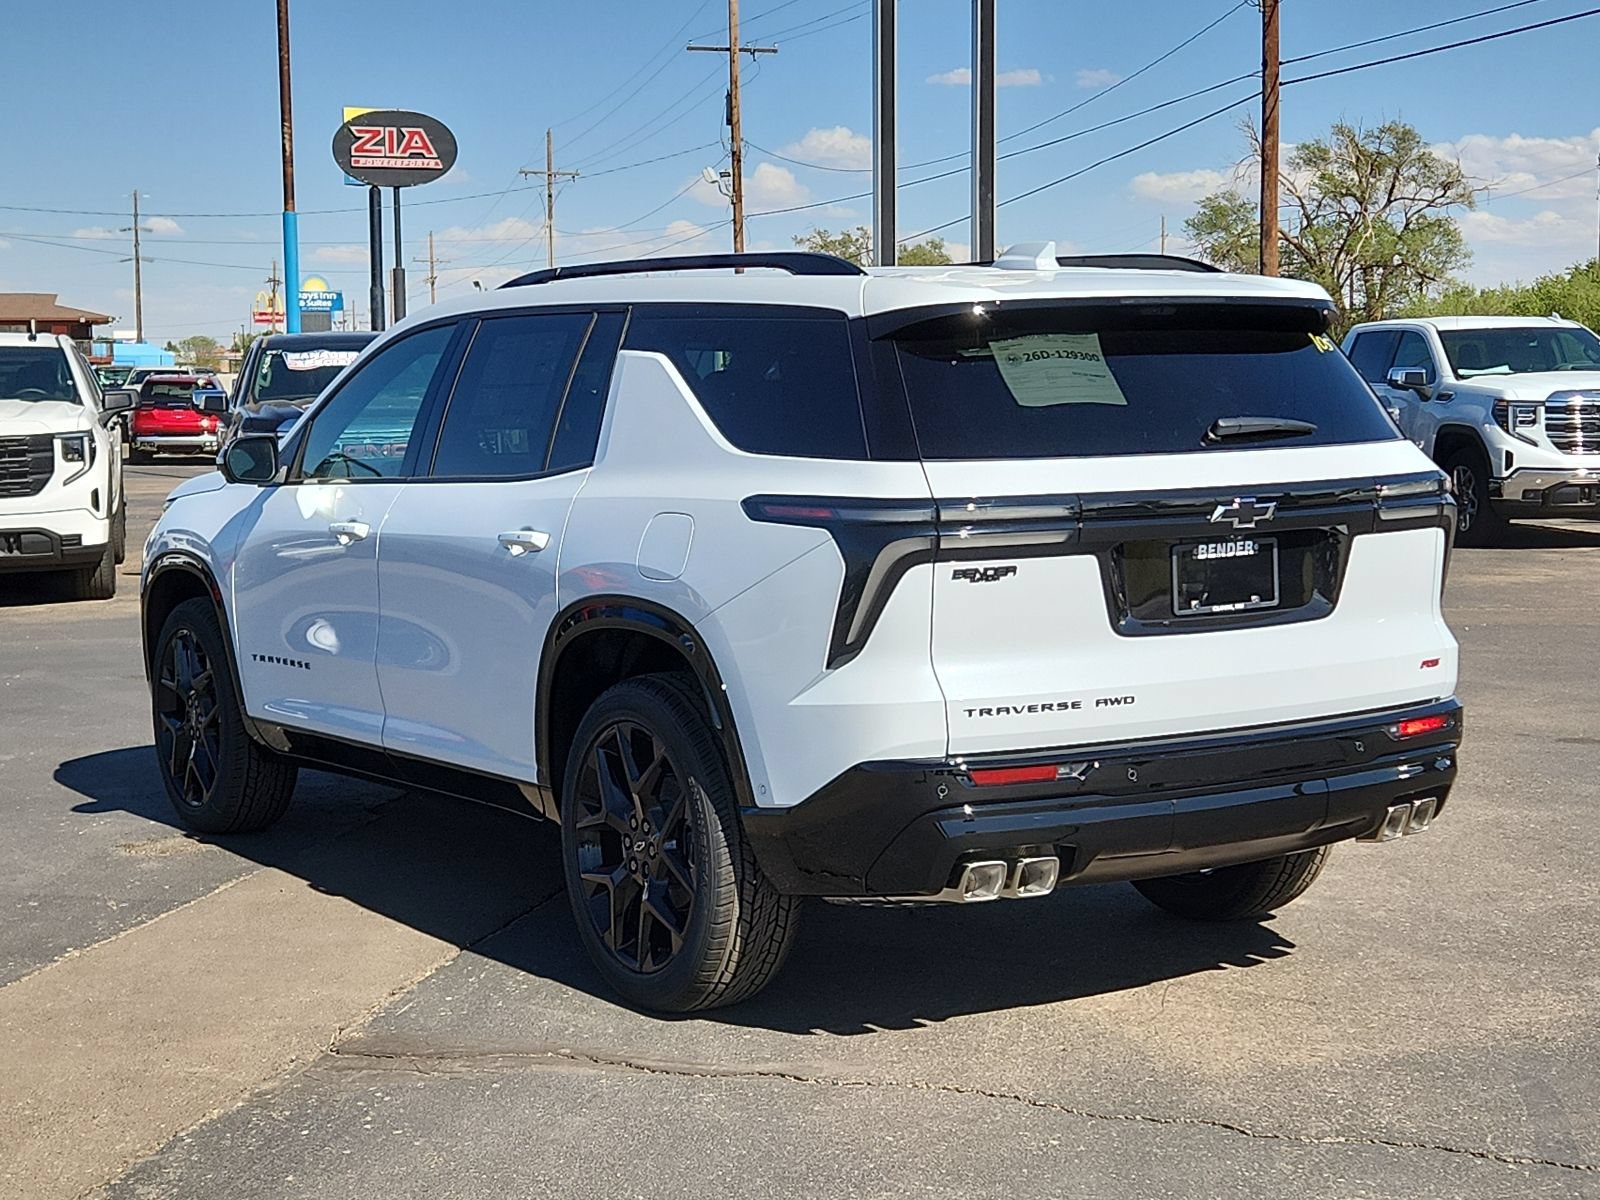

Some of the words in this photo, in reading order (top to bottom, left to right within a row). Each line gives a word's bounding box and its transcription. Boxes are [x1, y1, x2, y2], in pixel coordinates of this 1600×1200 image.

[348, 126, 438, 158] ZIA
[1022, 350, 1100, 362] 26D-129300
[1197, 540, 1254, 555] BENDER
[951, 565, 1018, 580] BENDER
[250, 653, 311, 670] TRAVERSE
[1420, 657, 1440, 669] RS
[963, 700, 1083, 718] TRAVERSE
[1095, 695, 1136, 708] AWD
